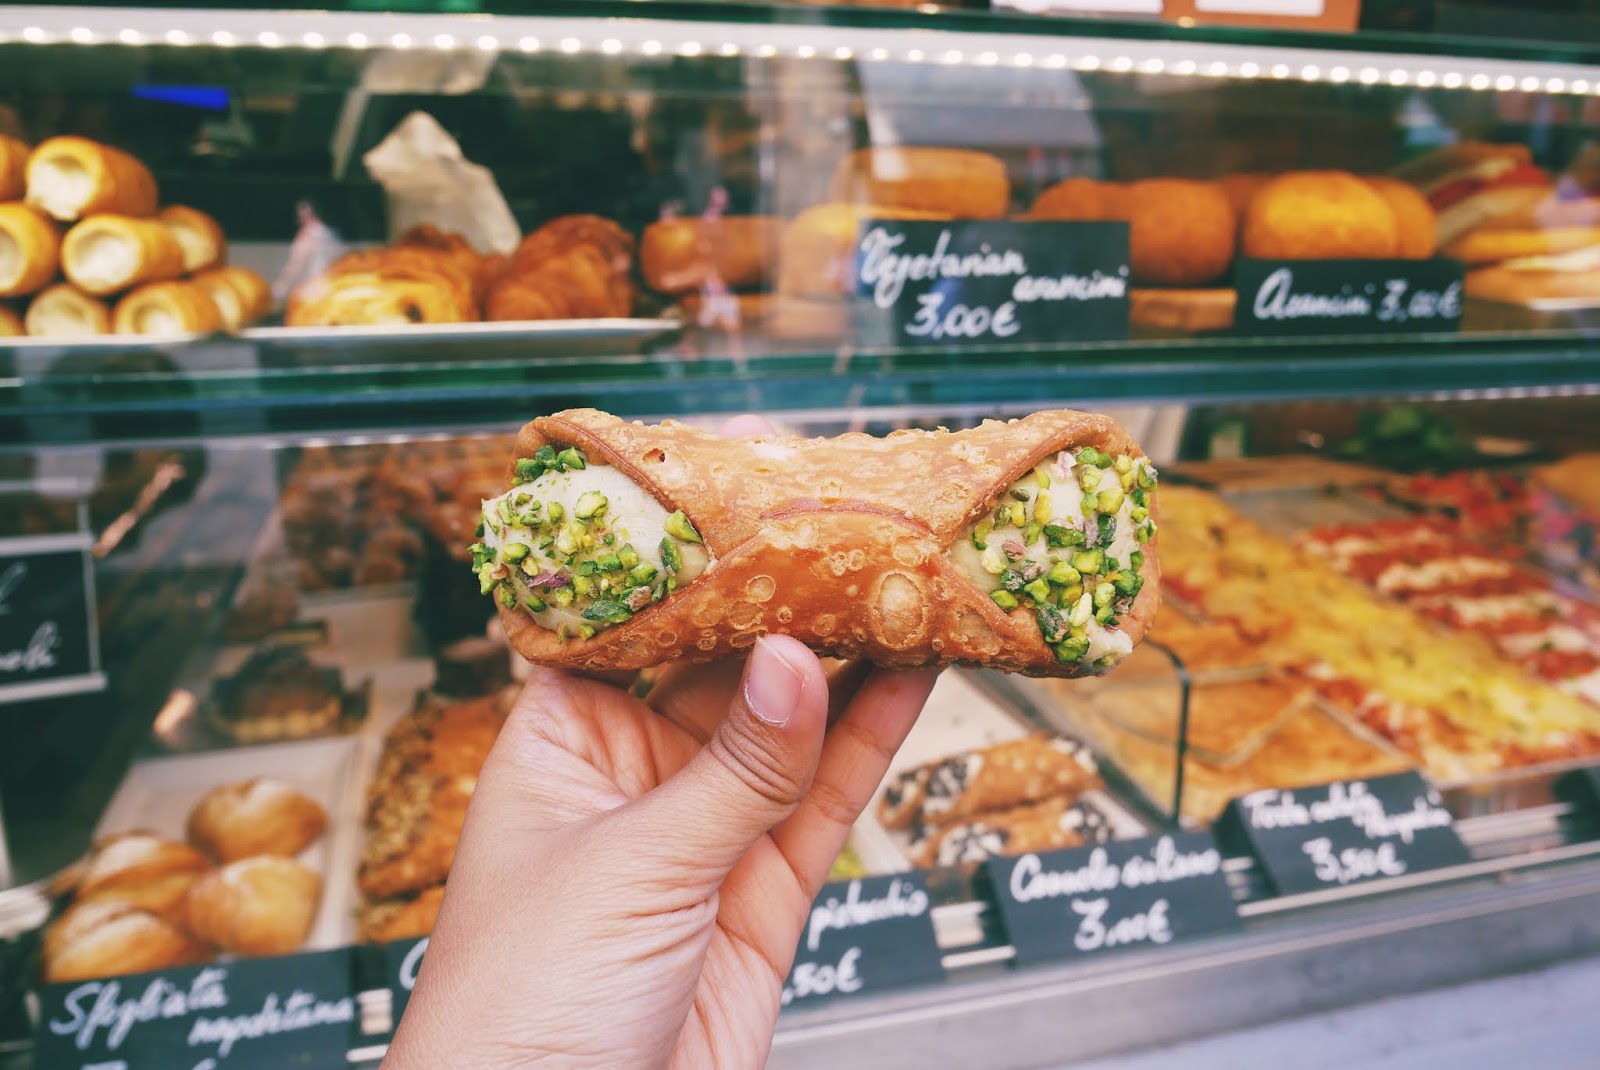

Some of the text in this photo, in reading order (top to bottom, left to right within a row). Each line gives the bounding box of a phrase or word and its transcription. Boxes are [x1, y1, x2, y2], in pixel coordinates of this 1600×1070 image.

[860, 227, 1027, 308] Vegetarian
[905, 292, 1021, 339] 3,00€
[781, 947, 864, 1005] ,50€
